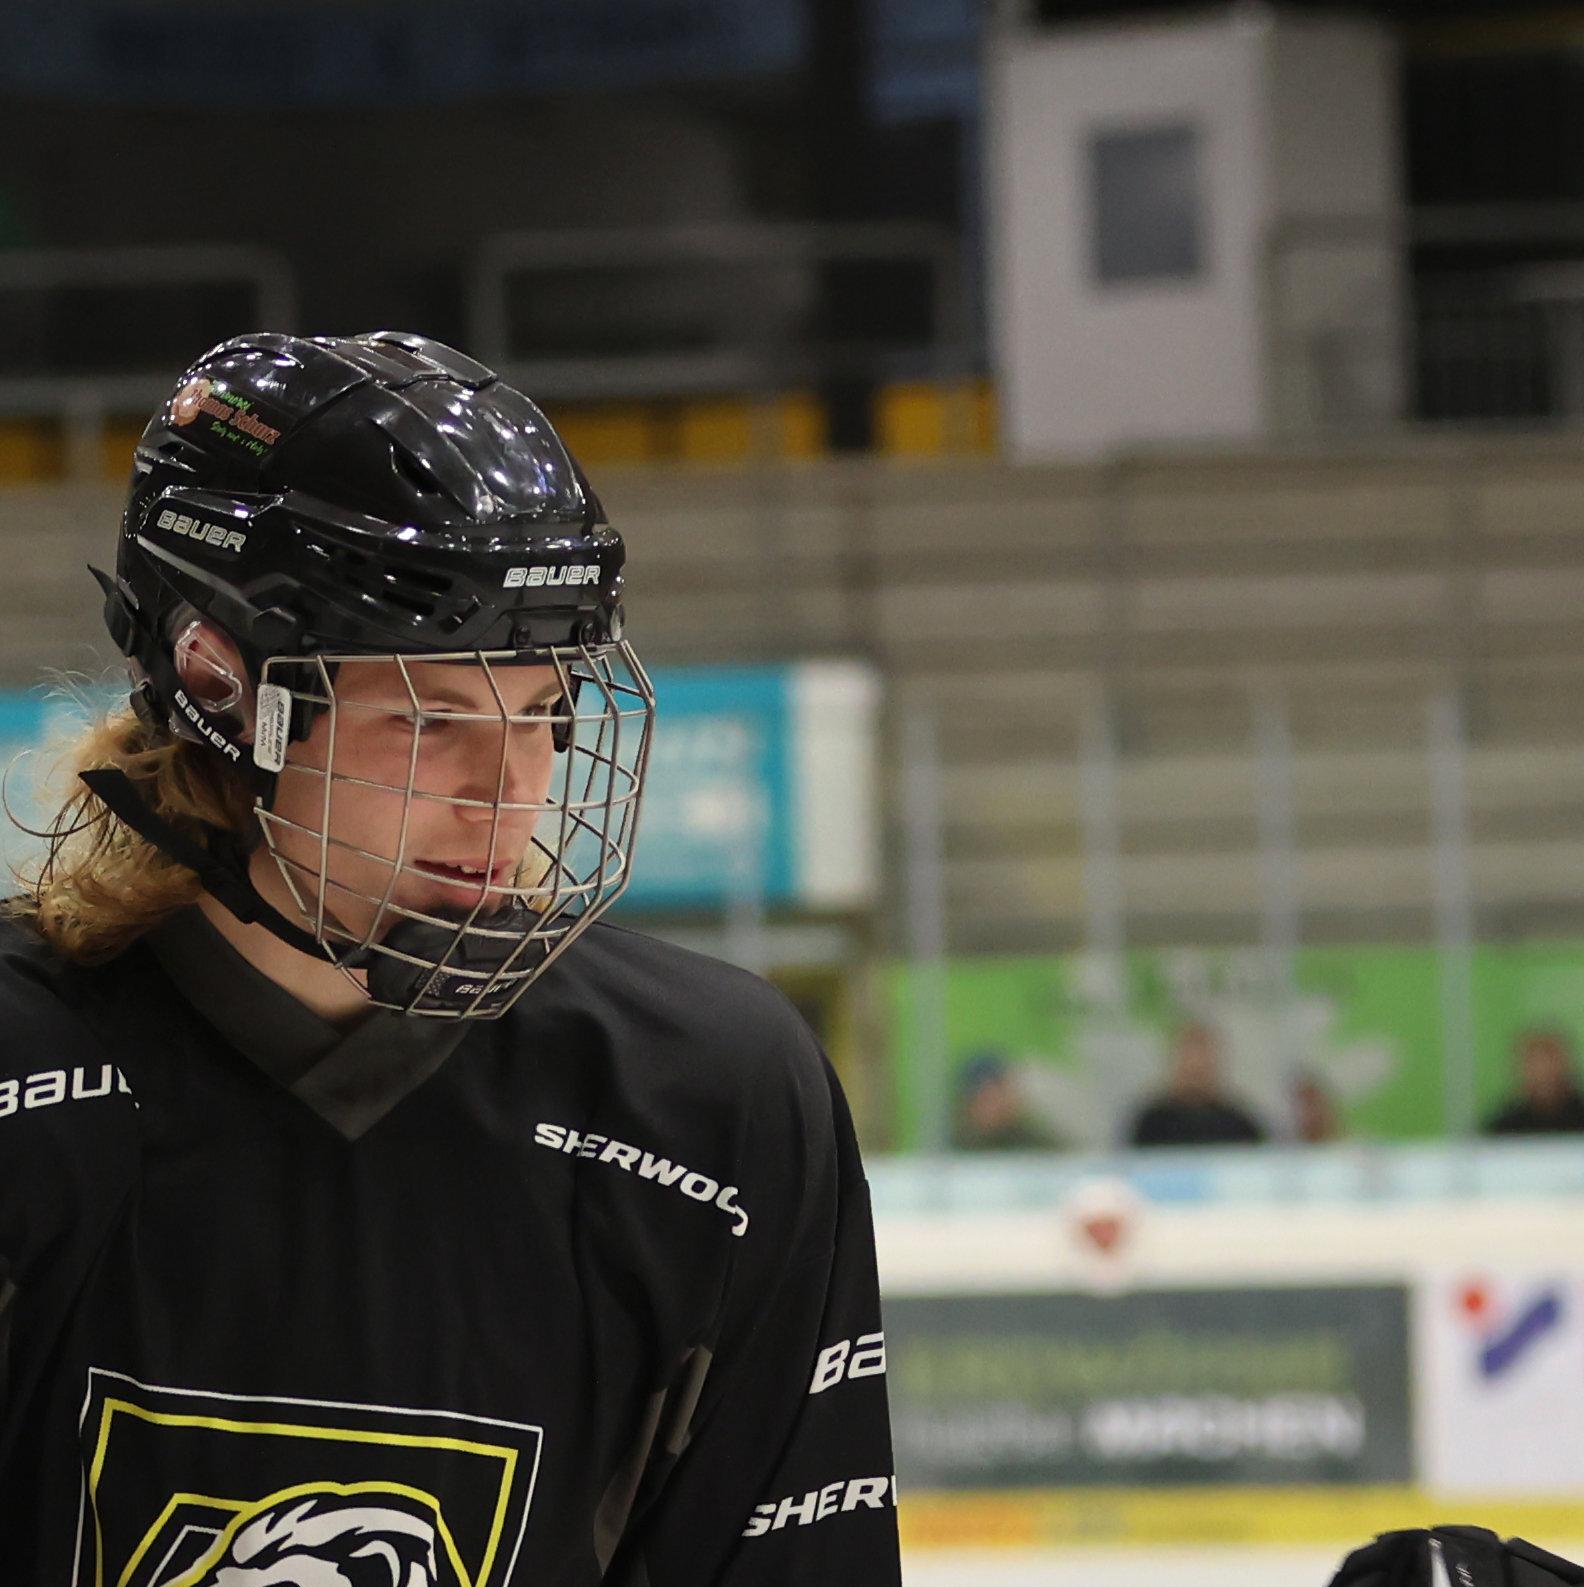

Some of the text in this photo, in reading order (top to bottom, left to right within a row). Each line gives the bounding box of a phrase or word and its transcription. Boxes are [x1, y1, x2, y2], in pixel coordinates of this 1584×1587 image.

[157, 509, 247, 552] BAUER
[503, 564, 601, 588] BAUER
[175, 689, 241, 762] BAUER
[273, 700, 285, 767] BAUER
[741, 1475, 897, 1537] SHER
